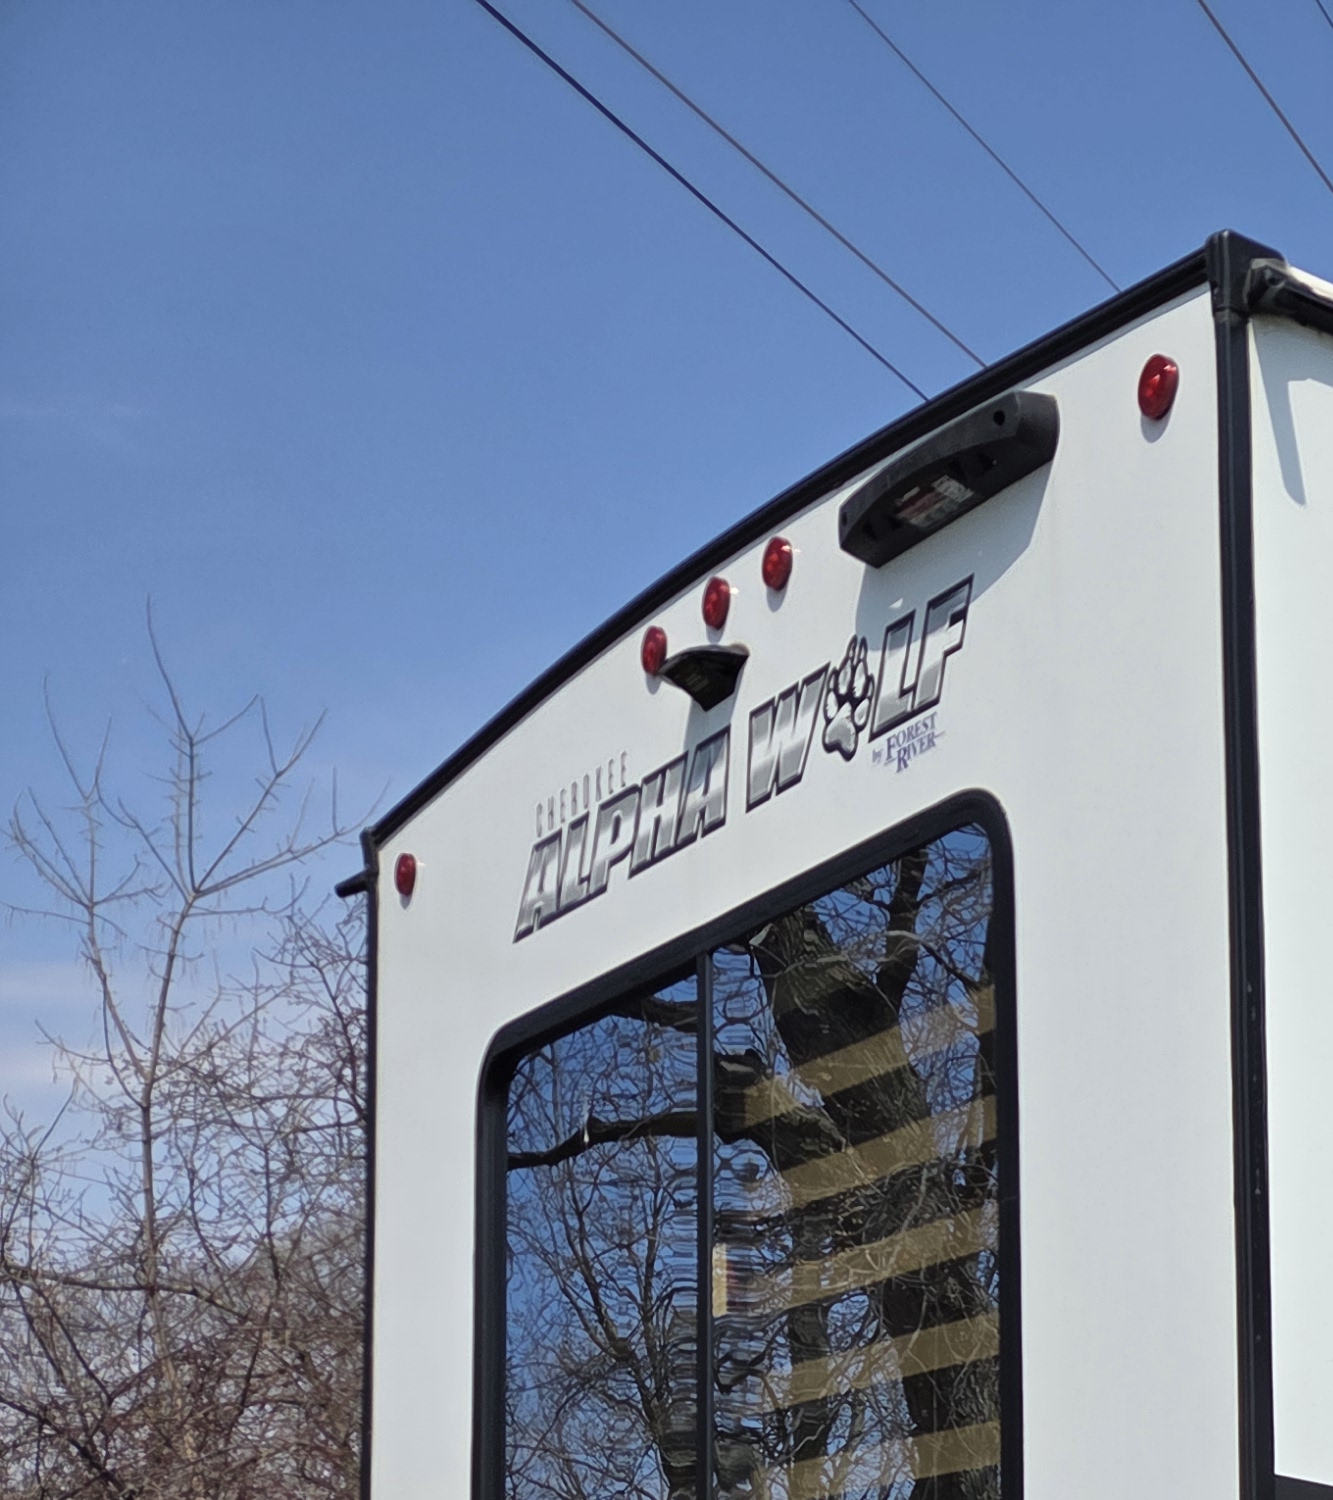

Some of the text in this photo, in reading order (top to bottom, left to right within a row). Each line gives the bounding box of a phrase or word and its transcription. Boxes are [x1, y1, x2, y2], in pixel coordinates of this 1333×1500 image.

[886, 711, 938, 762] FOREST
[896, 731, 938, 773] RIVER
[535, 751, 630, 838] CHEROKEE
[513, 725, 732, 943] ALPHA
